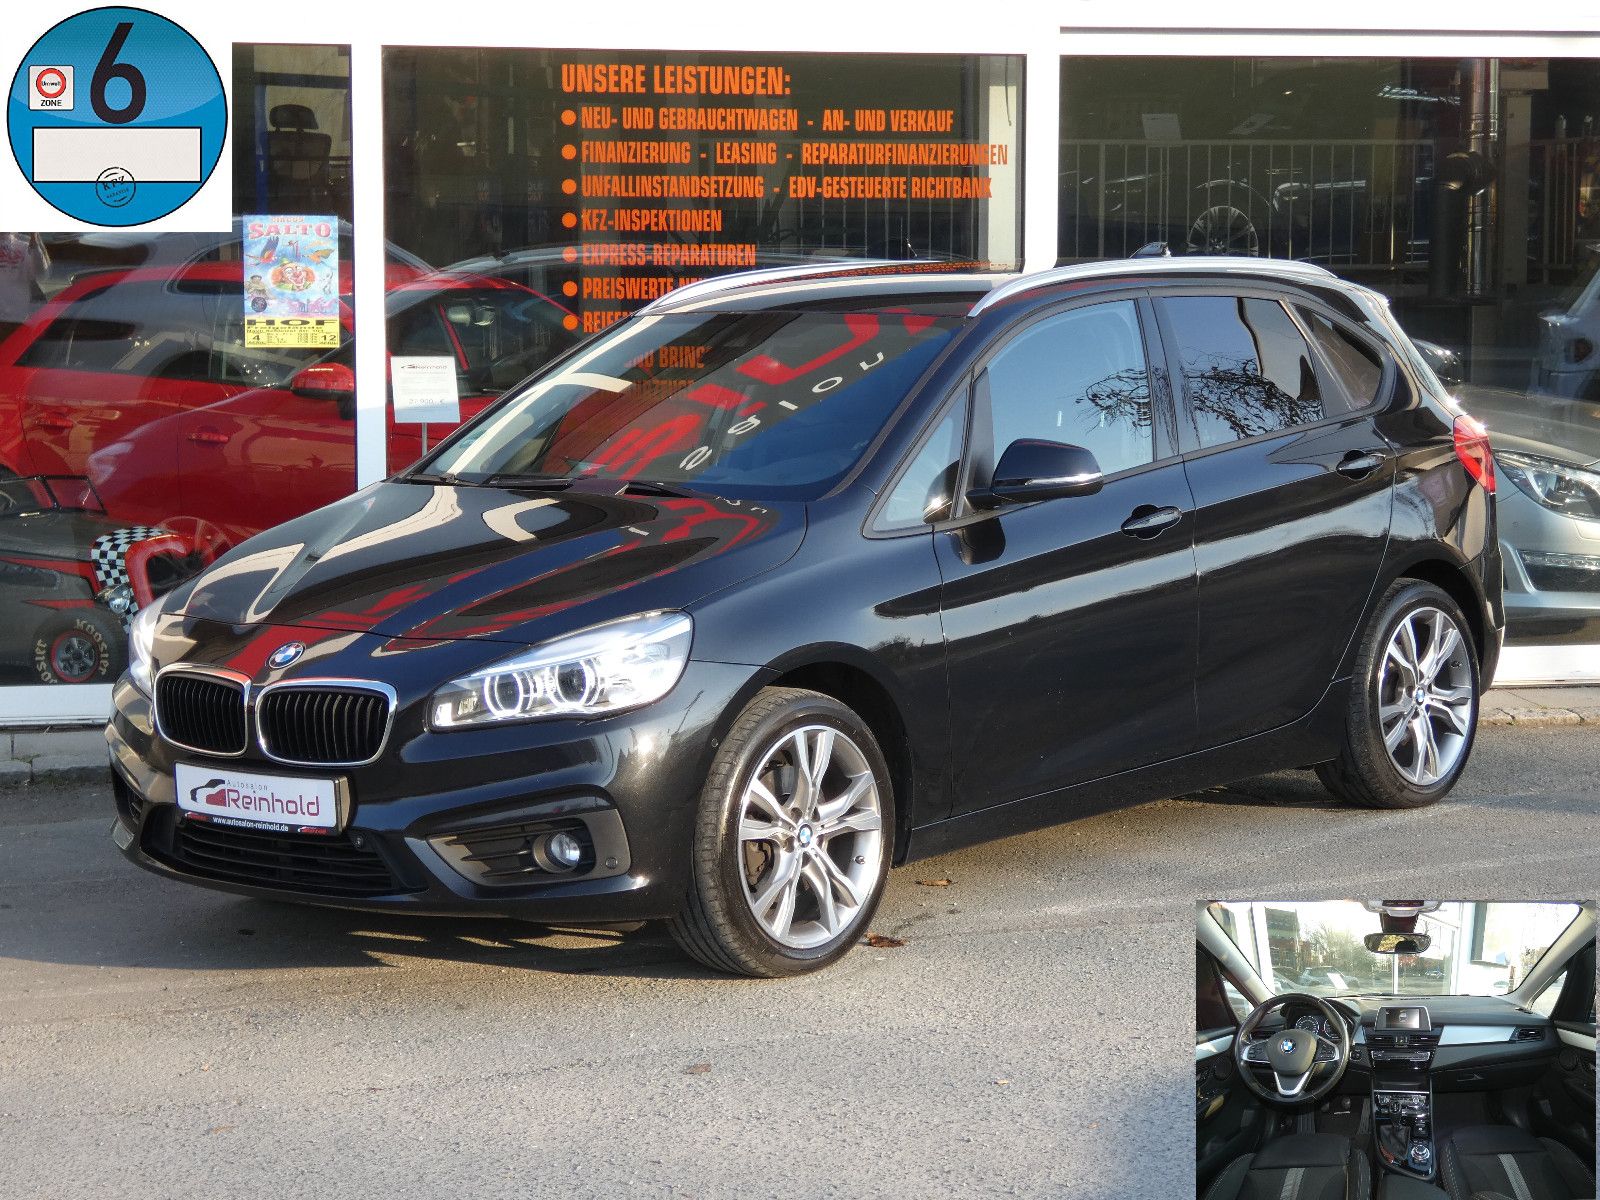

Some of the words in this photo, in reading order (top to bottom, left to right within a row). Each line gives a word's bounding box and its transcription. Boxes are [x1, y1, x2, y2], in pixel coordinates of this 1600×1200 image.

[561, 64, 646, 93] UNSERE
[653, 65, 791, 95] LEISTUNGEN:
[581, 106, 617, 129] NEU-
[622, 107, 654, 130] UND
[659, 108, 798, 131] GEBRAUCHTWAGEN
[822, 109, 850, 131] AN-
[855, 109, 886, 132] UND
[890, 110, 954, 132] VERKAUF
[581, 141, 691, 164] FINANZIERUNG
[716, 142, 777, 164] LEASING
[802, 143, 1008, 165] REPARATURFINANZIERUNGEN
[581, 175, 764, 198] UNFALLINSTANDSETZUNG
[789, 176, 907, 198] EDV-GESTEUERTE
[911, 177, 992, 199] RICHTBANK
[249, 222, 331, 240] SALTO
[581, 209, 722, 232] KFZ-INSPEKTIONEN
[582, 243, 756, 266] EXPRESS-REPARATUREN
[582, 277, 674, 300] PREISWERTE
[227, 779, 268, 790] Autosalon
[226, 788, 320, 816] Reinhold
[212, 817, 288, 832] www.autosalon-reinhold.de
